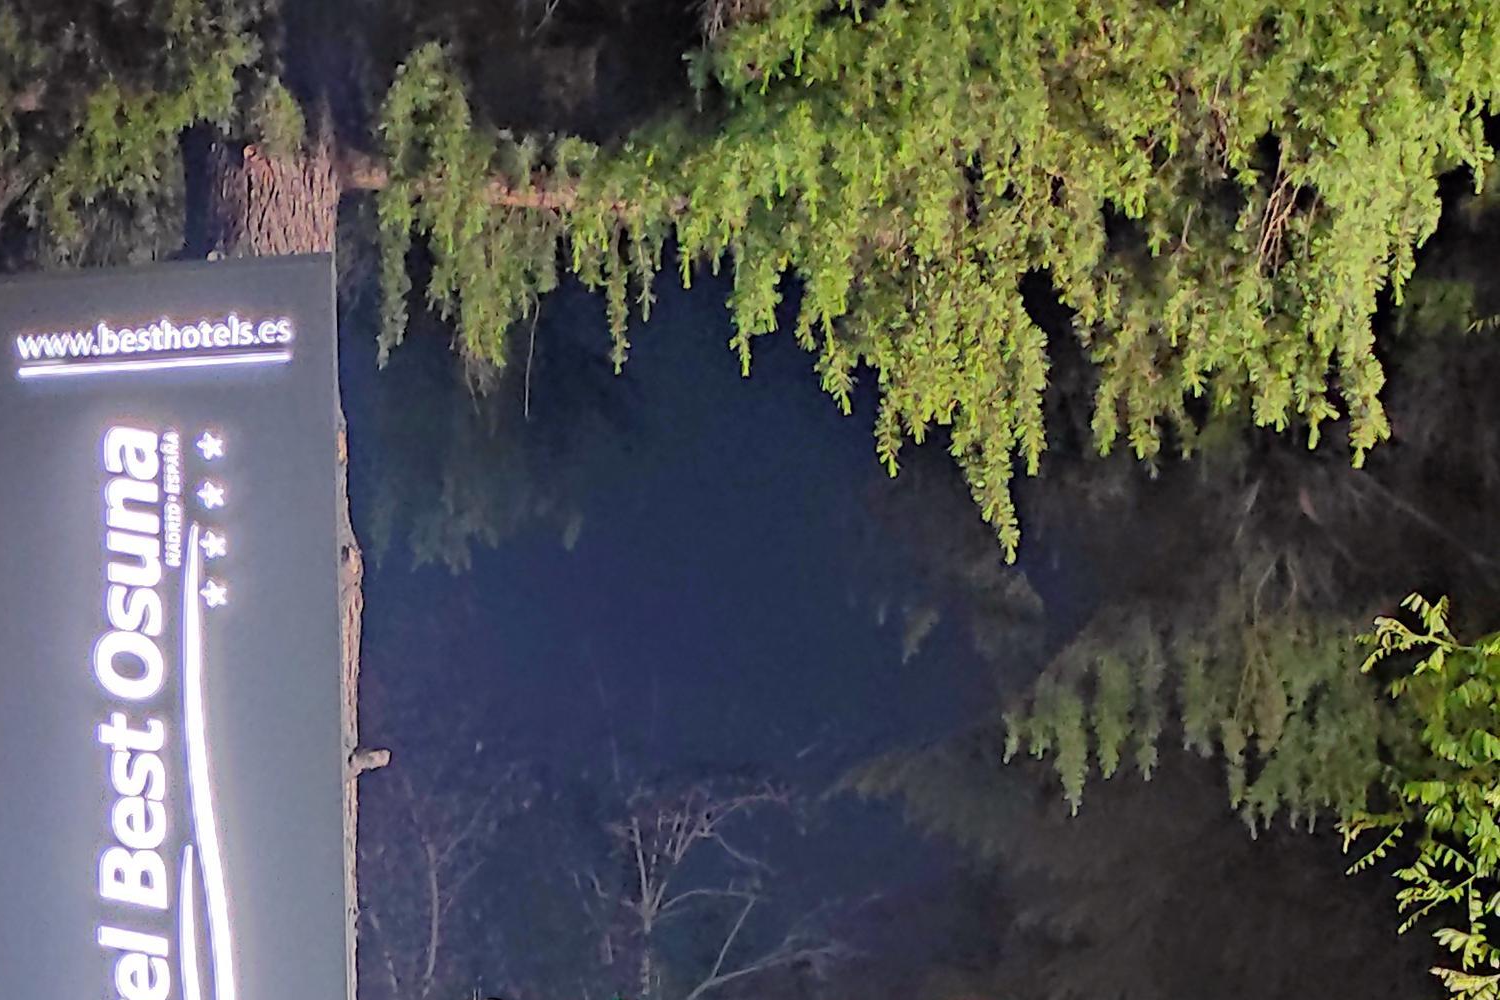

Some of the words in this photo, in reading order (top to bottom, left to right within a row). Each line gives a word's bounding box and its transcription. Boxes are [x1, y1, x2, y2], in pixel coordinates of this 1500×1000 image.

[16, 313, 293, 359] www.besthotels.es
[93, 426, 164, 700] Osuna
[162, 501, 182, 567] MADRID
[98, 712, 169, 909] Best
